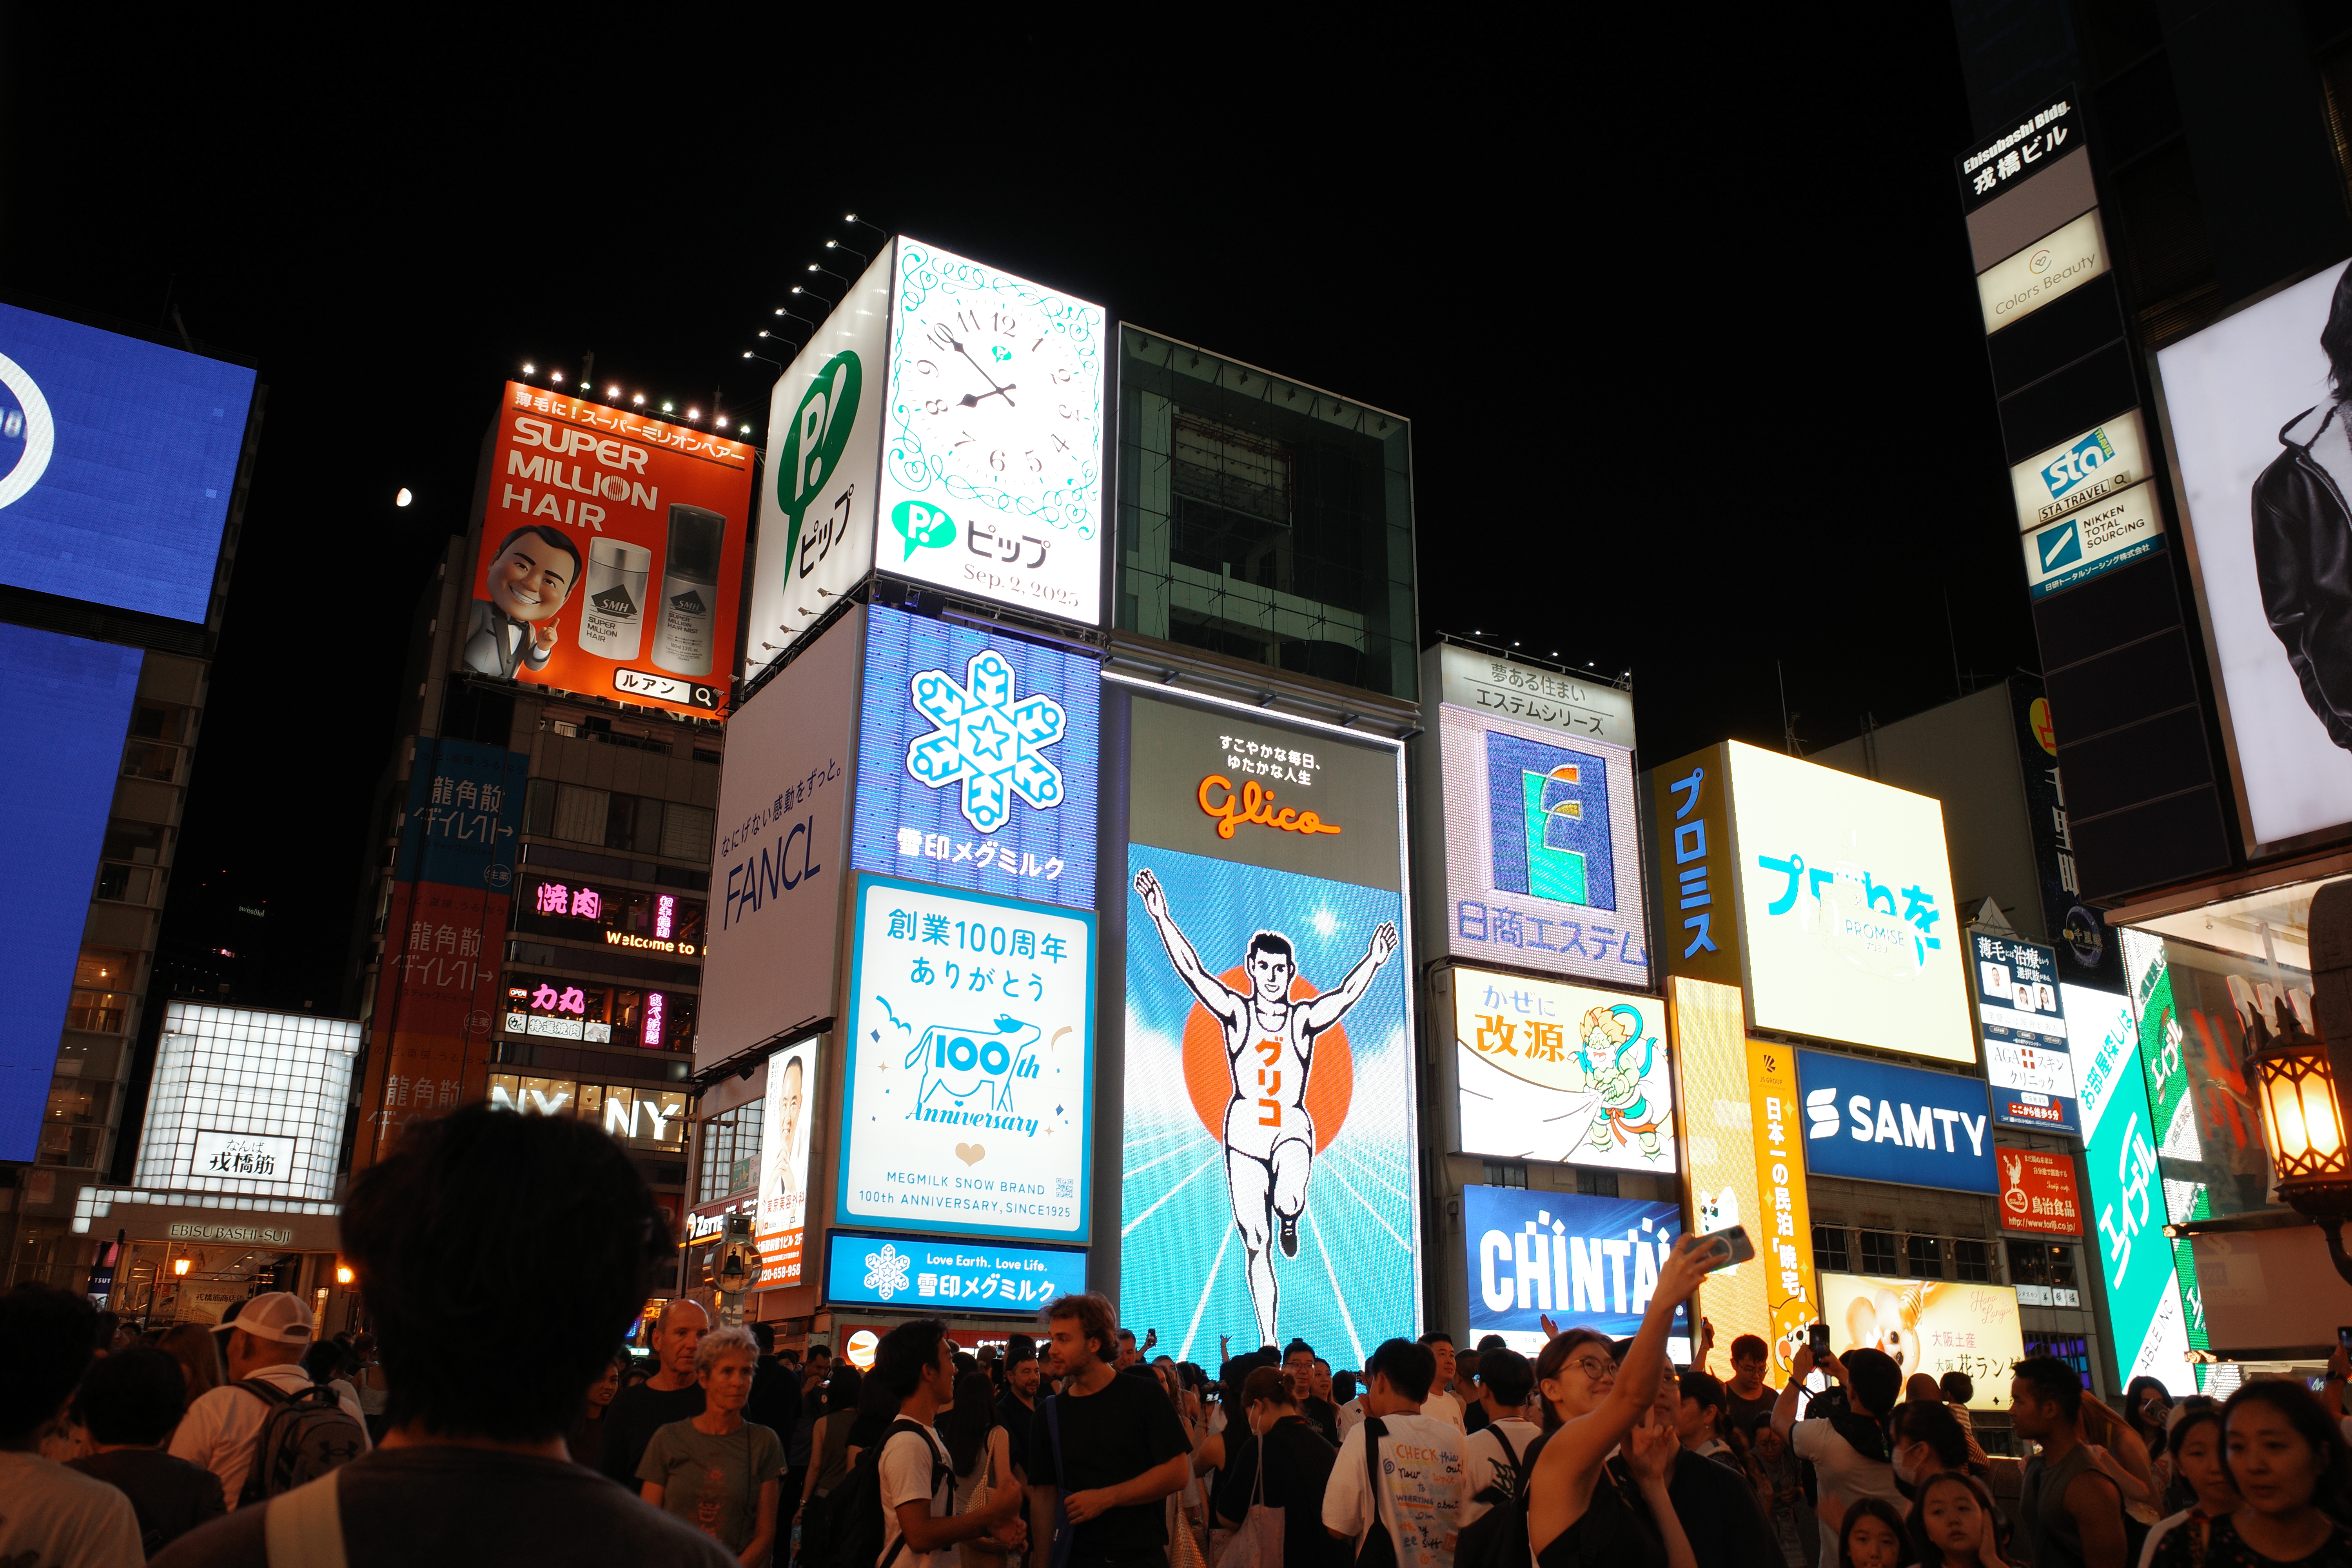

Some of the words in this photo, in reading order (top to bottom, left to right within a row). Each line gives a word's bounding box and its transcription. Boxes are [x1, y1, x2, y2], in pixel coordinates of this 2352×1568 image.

[1964, 120, 2034, 174] Ebisubashi
[2034, 100, 2071, 129] Bldg.
[1973, 126, 2068, 195] 戎橋ビル
[1995, 284, 2039, 314] Colors
[2044, 254, 2095, 289] Beauty
[956, 309, 981, 333] 11
[990, 311, 1017, 338] 12
[916, 359, 939, 377] 9
[1050, 368, 1071, 385] 2
[925, 399, 948, 416] 8
[1058, 405, 1080, 421] 3
[512, 417, 649, 475] SUPER
[954, 430, 976, 446] 7
[1051, 434, 1070, 453] 4
[2094, 428, 2114, 458] TRAVEL
[989, 450, 1005, 471] 6
[1029, 450, 1042, 473] 5
[2050, 446, 2104, 491] sta
[507, 450, 658, 511] MILLION
[502, 483, 606, 532] HAIR
[2042, 504, 2063, 519] STA
[2064, 483, 2108, 509] TRAVEL
[2083, 505, 2125, 528] NIKKEN
[2085, 519, 2120, 539] TOTAL
[800, 483, 854, 579] ピップ
[967, 520, 1051, 569] ピップ
[2087, 519, 2145, 549] SOURCING
[2045, 543, 2151, 592] 日研トータルソーシング株式会社
[964, 564, 1004, 590] Sep.
[1009, 575, 1026, 596] 2,
[1031, 581, 1078, 608] 2025
[601, 599, 629, 612] SMH
[668, 612, 690, 622] SUPER
[678, 600, 700, 610] SMH
[586, 630, 606, 642] HAIR
[587, 623, 618, 637] MILLION
[588, 616, 615, 630] SUPER
[668, 618, 692, 628] MILLION
[668, 622, 682, 631] HAIR
[622, 673, 675, 695] ルアン
[1491, 663, 1586, 702] 夢ある住まい
[1477, 688, 1604, 736] エステムシリーズ
[1220, 735, 1321, 771] すこやかな毎日、
[1227, 754, 1312, 786] ゆたかな人生
[432, 775, 505, 814] 龍角散
[721, 758, 841, 858] なにげない感動をずっと。
[1198, 774, 1341, 839] Glico
[897, 826, 1065, 882] 雪印メグミルク
[1670, 767, 1718, 960] プロミス
[724, 814, 821, 931] FANCL
[537, 883, 601, 919] 焼肉
[409, 920, 486, 958] 龍角散
[606, 931, 675, 952] Welcome
[678, 942, 695, 955] to
[886, 908, 1068, 964] 創業100周年
[1459, 900, 1648, 967] 日商エステム
[1846, 919, 1904, 946] PROMISE
[910, 957, 1044, 1002] ありがとう
[530, 983, 585, 1014] 力丸
[1482, 984, 1555, 1018] かぜに
[529, 1019, 581, 1037] 特選焼肉
[1474, 1013, 1564, 1062] 改源
[935, 1035, 1040, 1080] 100th
[1994, 1047, 2021, 1065] AGA
[2038, 1056, 2064, 1072] スキン
[2080, 1009, 2133, 1111] お部屋探しは
[1254, 1035, 1284, 1128] グリコ
[2010, 1070, 2054, 1091] クリニック
[604, 1097, 681, 1140] NY
[906, 1101, 1039, 1138] Anniversary
[1849, 1094, 1987, 1157] SAMTY
[2011, 1105, 2059, 1121] ここから徒歩5分
[226, 1138, 265, 1154] なんば
[207, 1152, 276, 1176] 戎橋筋
[858, 1190, 895, 1204] 100th
[886, 1171, 949, 1187] MEGMILK
[955, 1177, 996, 1191] SNOW
[1000, 1181, 1045, 1196] BRAND
[2098, 1123, 2157, 1270] エイブル
[766, 1191, 804, 1214] 東京美容外科
[2032, 1196, 2075, 1218] 鳥治食品
[171, 1224, 213, 1237] EBISU
[216, 1227, 290, 1245] BASHI-SUJI
[696, 1214, 724, 1238] ZETTE
[794, 1232, 803, 1246] 2F
[757, 1263, 801, 1283] 120-658-958
[926, 1253, 953, 1267] Love
[956, 1255, 991, 1270] Earth.
[996, 1258, 1021, 1270] Love
[1023, 1258, 1048, 1272] Life.
[916, 1272, 1055, 1303] 雪印メグミルク
[1970, 1290, 1998, 1312] Hana
[1981, 1304, 2014, 1325] Langue
[1932, 1331, 1976, 1349] 大阪土産
[2141, 1327, 2162, 1375] ABLE
[1396, 1444, 1438, 1461] CHECK
